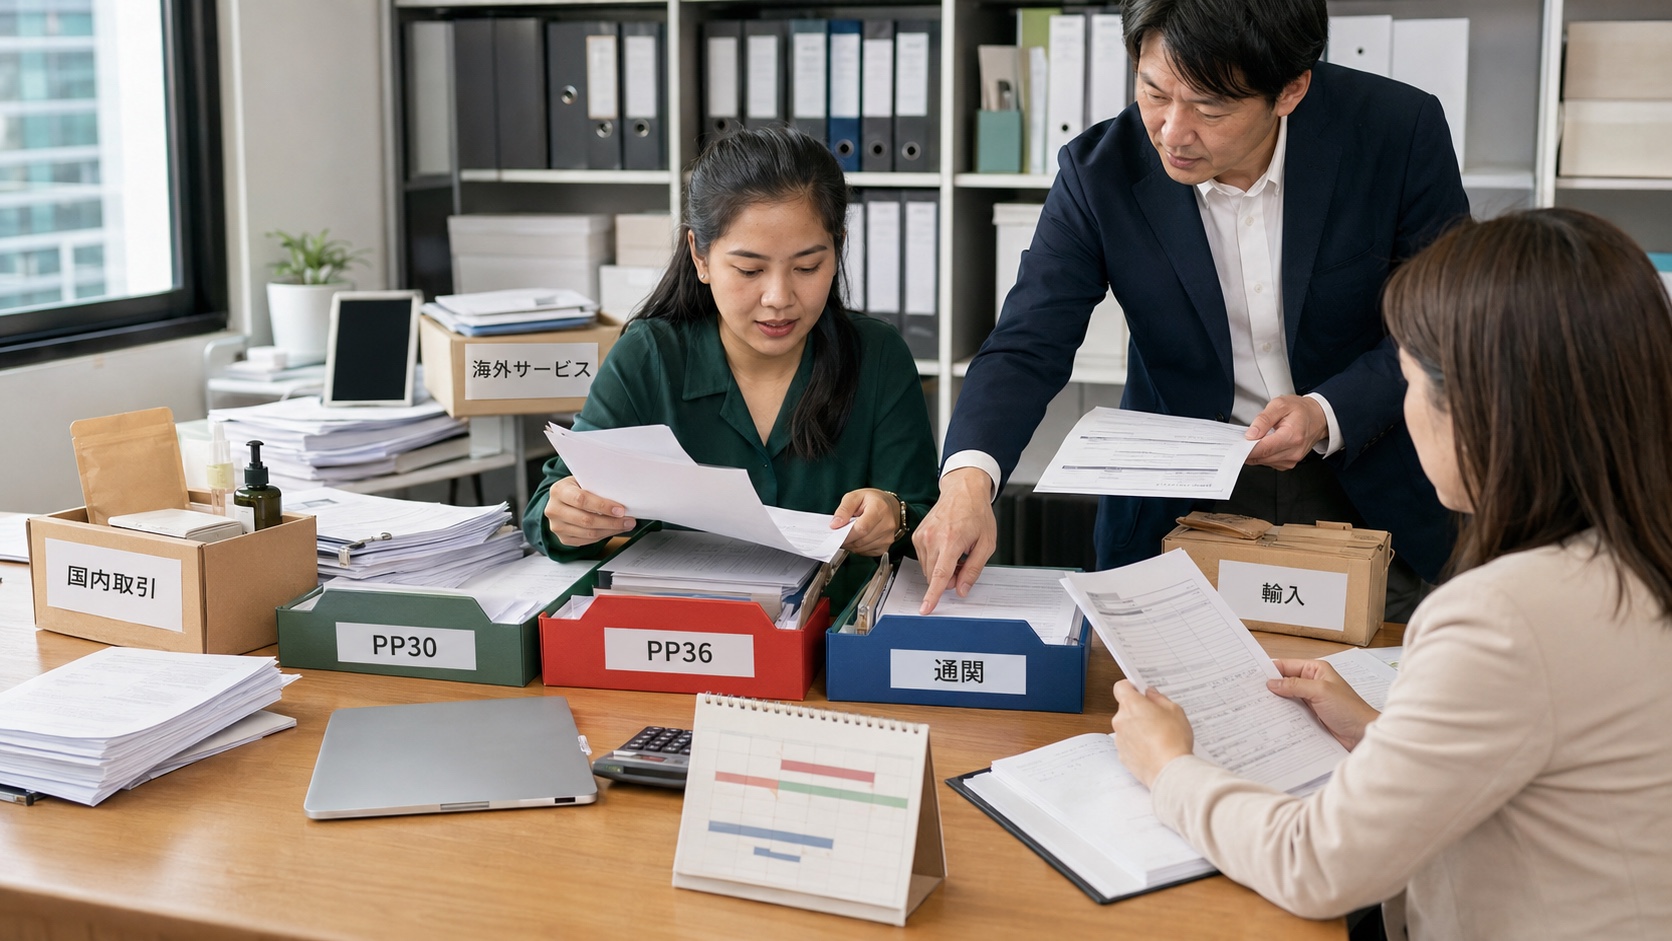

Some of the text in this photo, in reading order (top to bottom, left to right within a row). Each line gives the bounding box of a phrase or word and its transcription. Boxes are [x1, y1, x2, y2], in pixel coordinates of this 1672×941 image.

[472, 359, 591, 379] 海外サービス
[68, 565, 156, 600] 国内取引
[1261, 582, 1305, 606] 輸入
[373, 634, 438, 658] PP30
[647, 640, 713, 664] PP36
[934, 658, 984, 684] 通関
